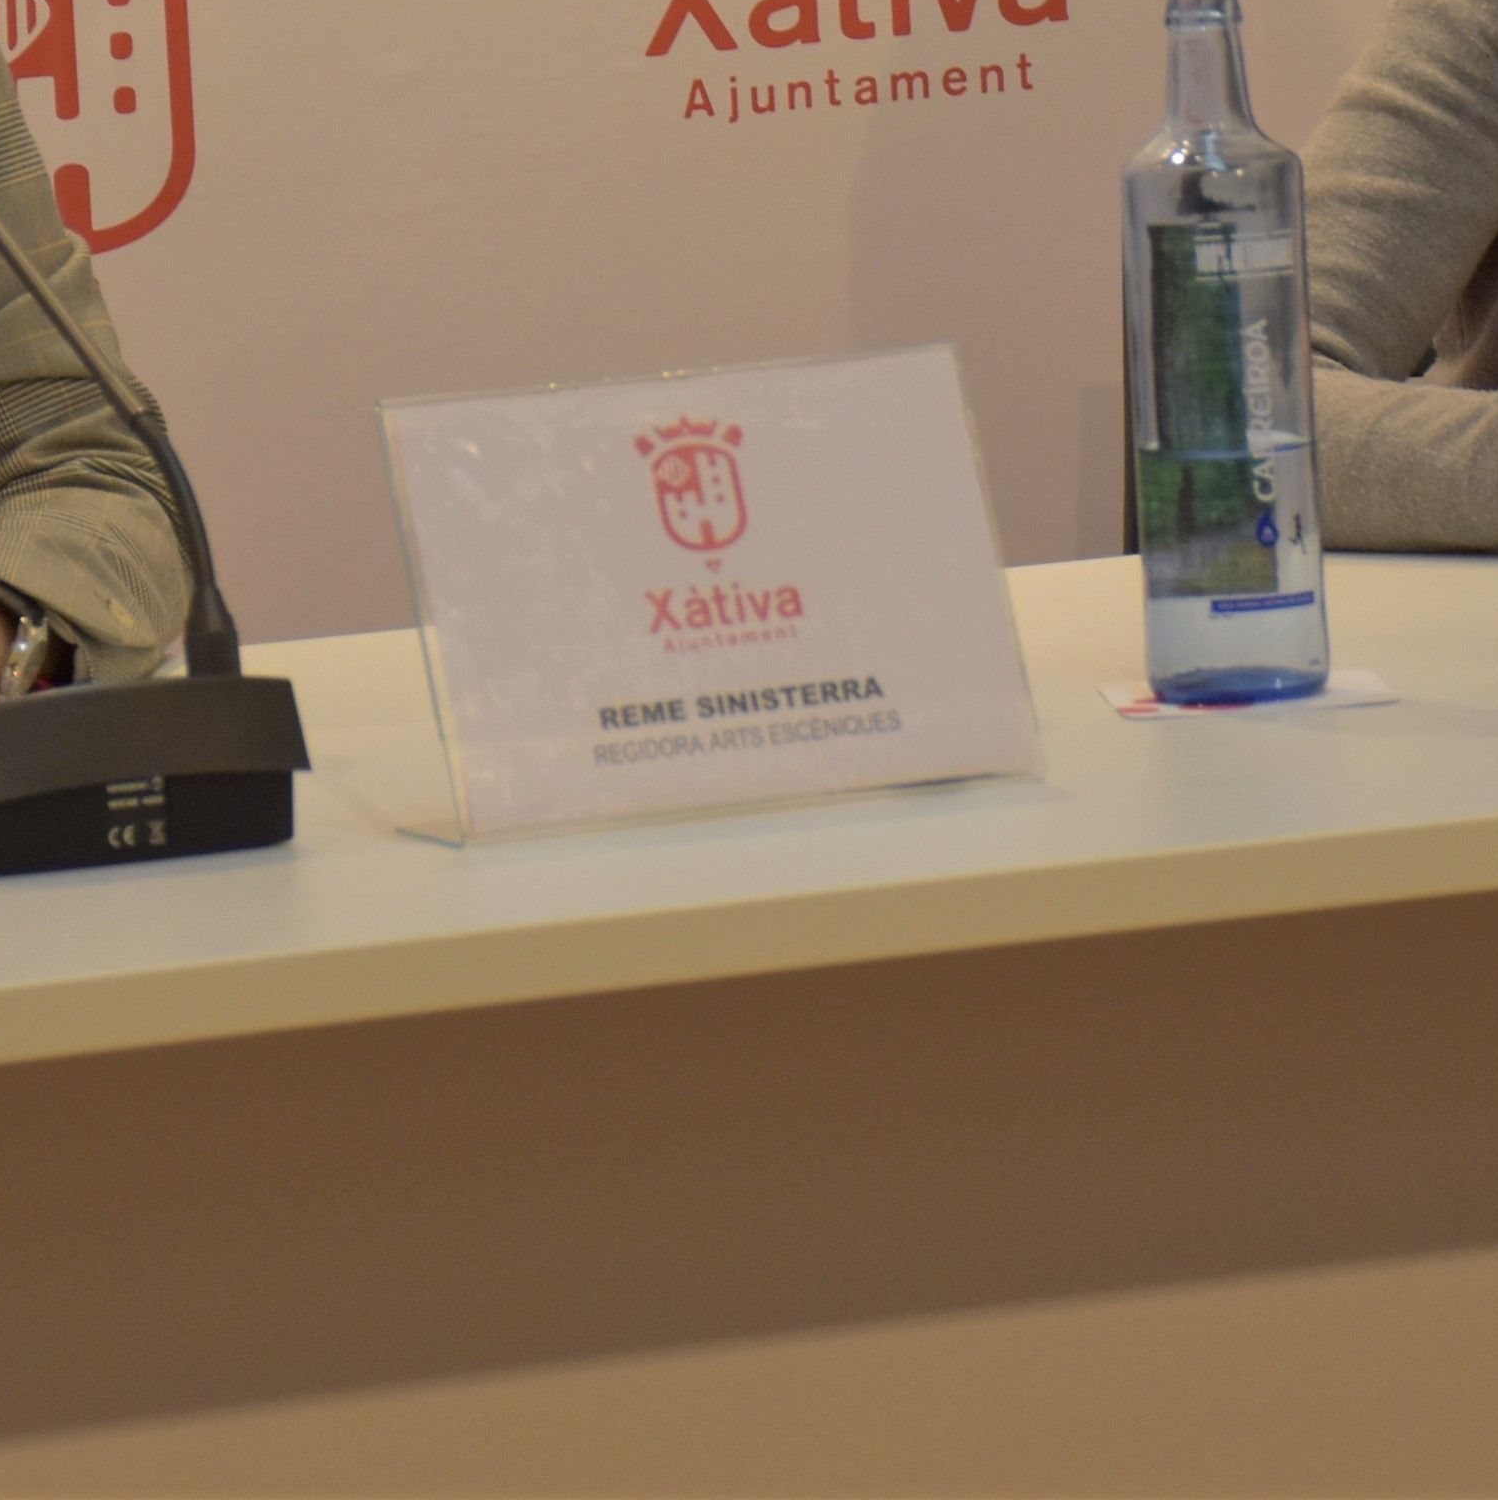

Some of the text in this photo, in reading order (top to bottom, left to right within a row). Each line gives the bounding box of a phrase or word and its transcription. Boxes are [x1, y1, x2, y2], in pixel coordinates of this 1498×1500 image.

[684, 53, 1033, 123] Ajuntament
[644, 581, 804, 633] Xàtiva
[598, 676, 884, 730] REME SINISTERRA
[710, 726, 764, 752] ARTS
